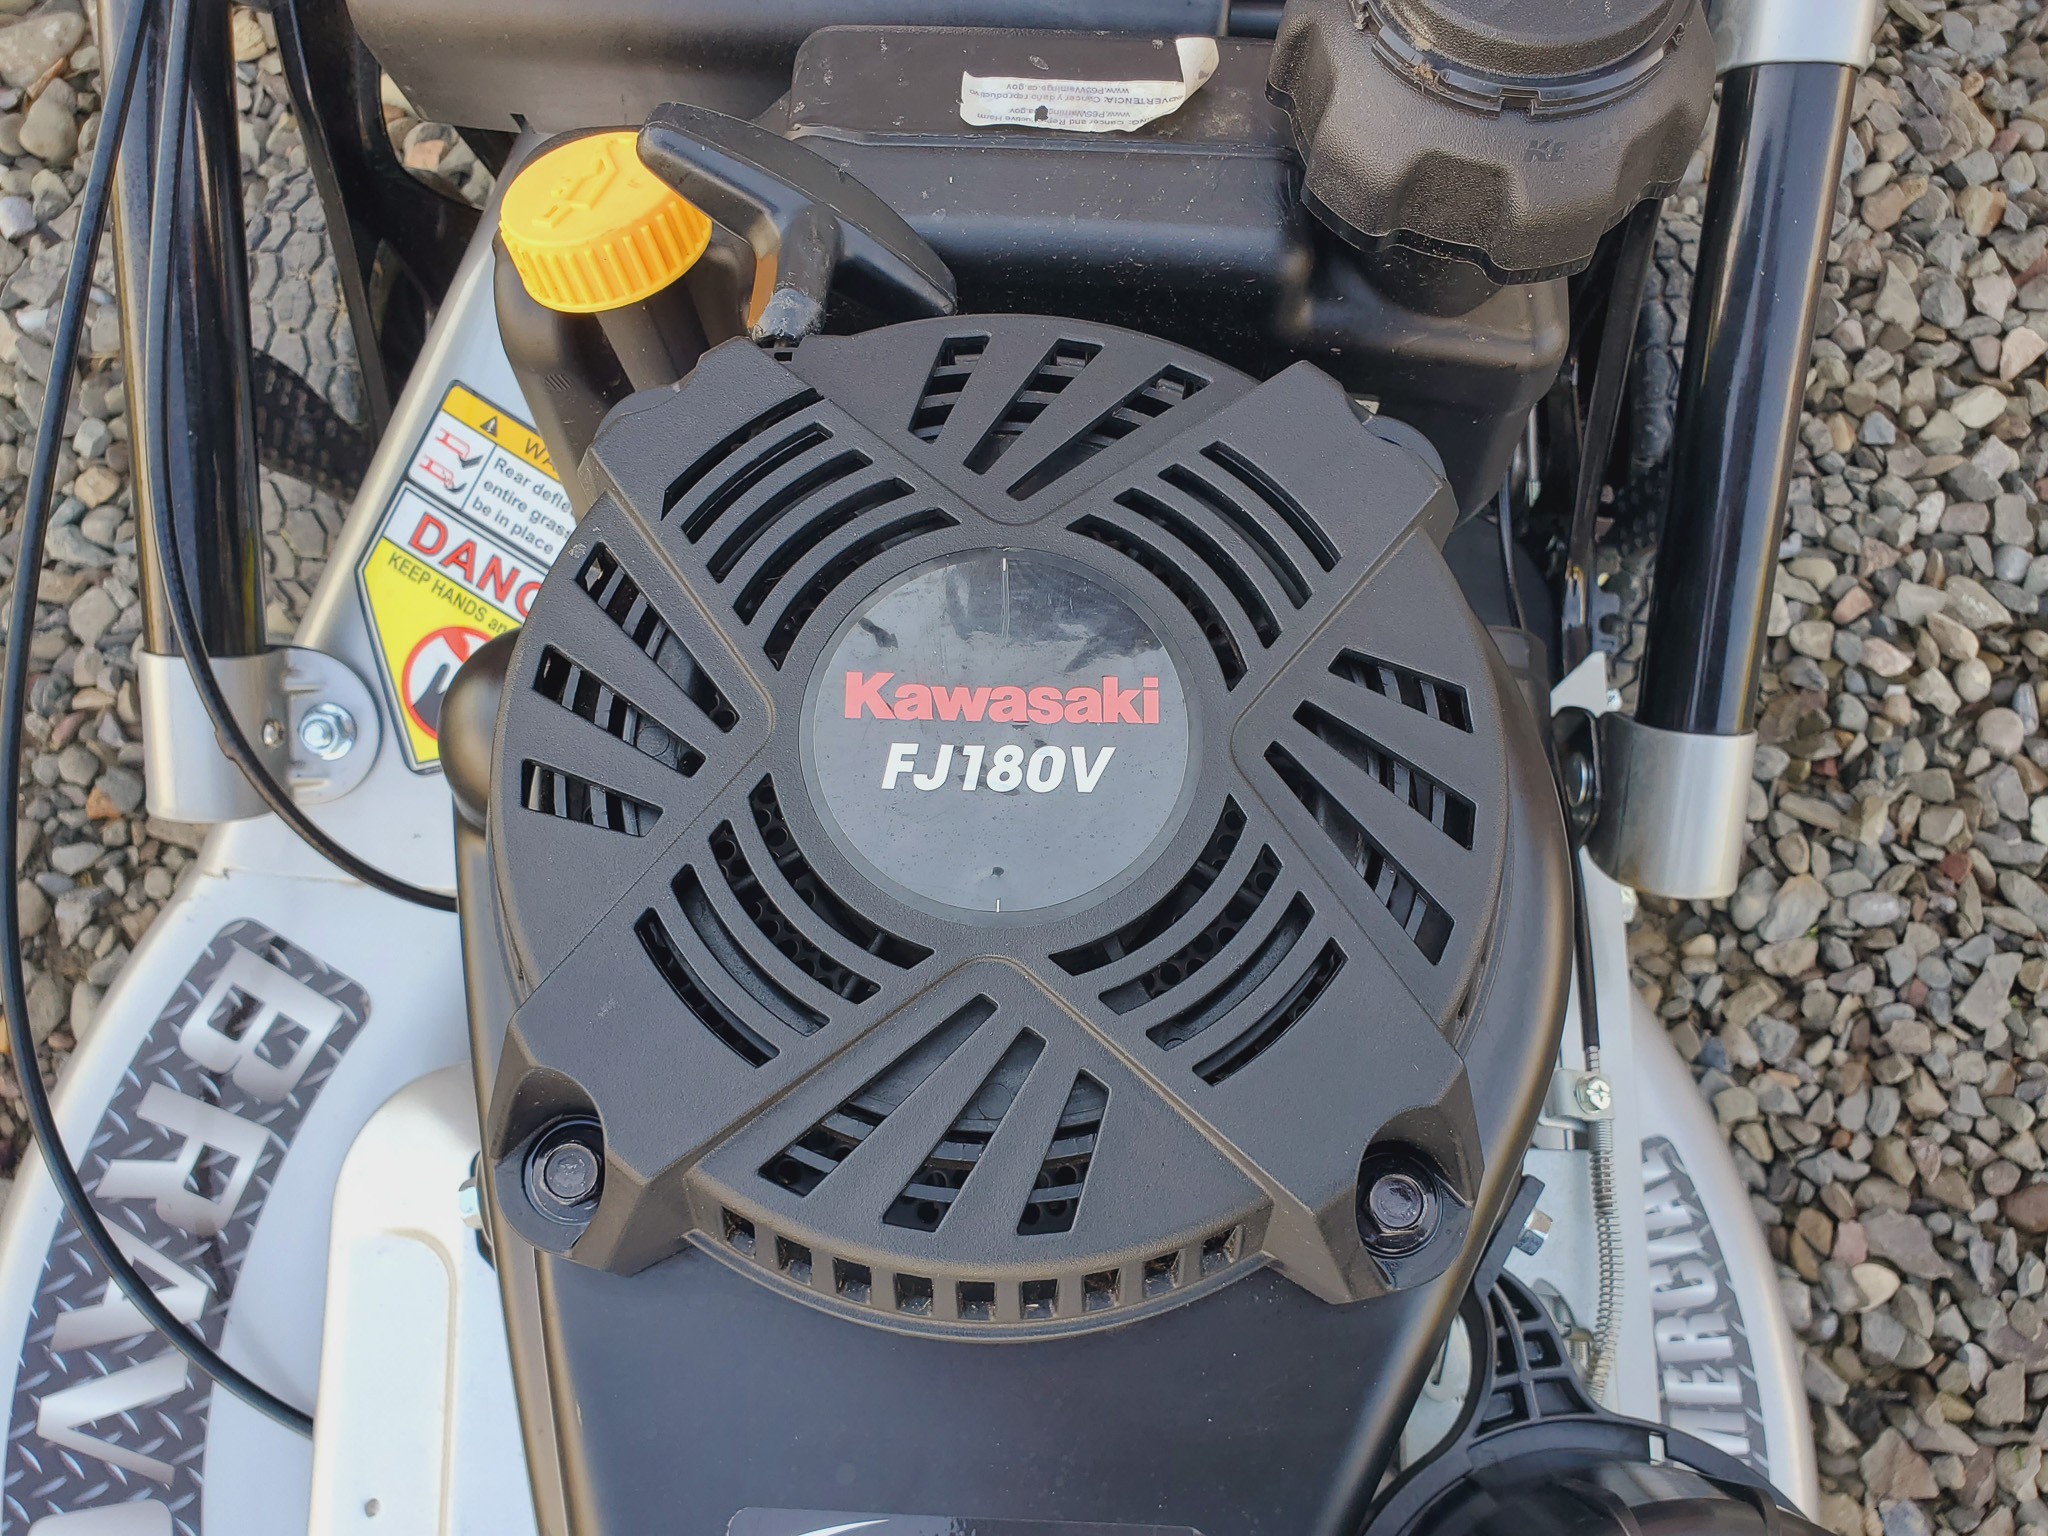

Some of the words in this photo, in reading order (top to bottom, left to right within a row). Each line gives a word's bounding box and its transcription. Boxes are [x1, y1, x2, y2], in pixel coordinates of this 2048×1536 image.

[969, 89, 1028, 101] reproductivo
[1009, 107, 1131, 118] www.P65Warninga.gov
[977, 113, 1002, 122] Harm
[1005, 115, 1066, 126] Repuctive
[483, 480, 528, 513] entire
[494, 457, 531, 487] Rear
[532, 483, 574, 515] defle
[472, 496, 493, 517] be
[494, 508, 510, 527] in
[510, 523, 554, 555] place
[387, 551, 431, 585] KEEP
[430, 578, 488, 622] HANDS
[844, 671, 1160, 724] Kawasaki
[881, 742, 1116, 793] FJ180V
